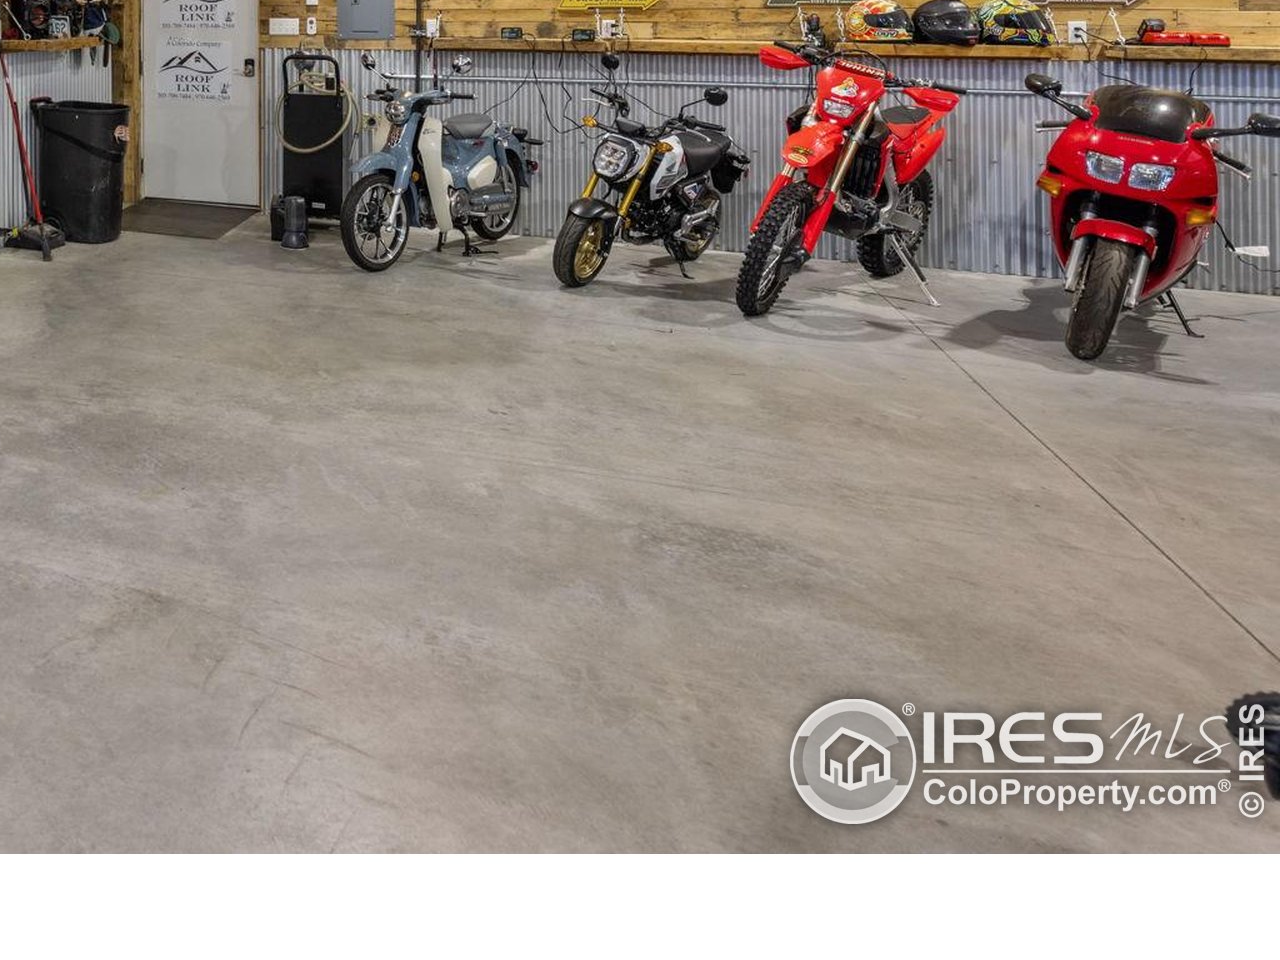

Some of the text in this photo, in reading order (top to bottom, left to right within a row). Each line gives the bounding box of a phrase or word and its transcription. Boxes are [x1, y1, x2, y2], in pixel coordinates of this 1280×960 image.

[179, 4, 218, 12] ROOF
[181, 13, 216, 21] LINK
[175, 74, 214, 83] ROOF
[177, 84, 210, 93] LINK
